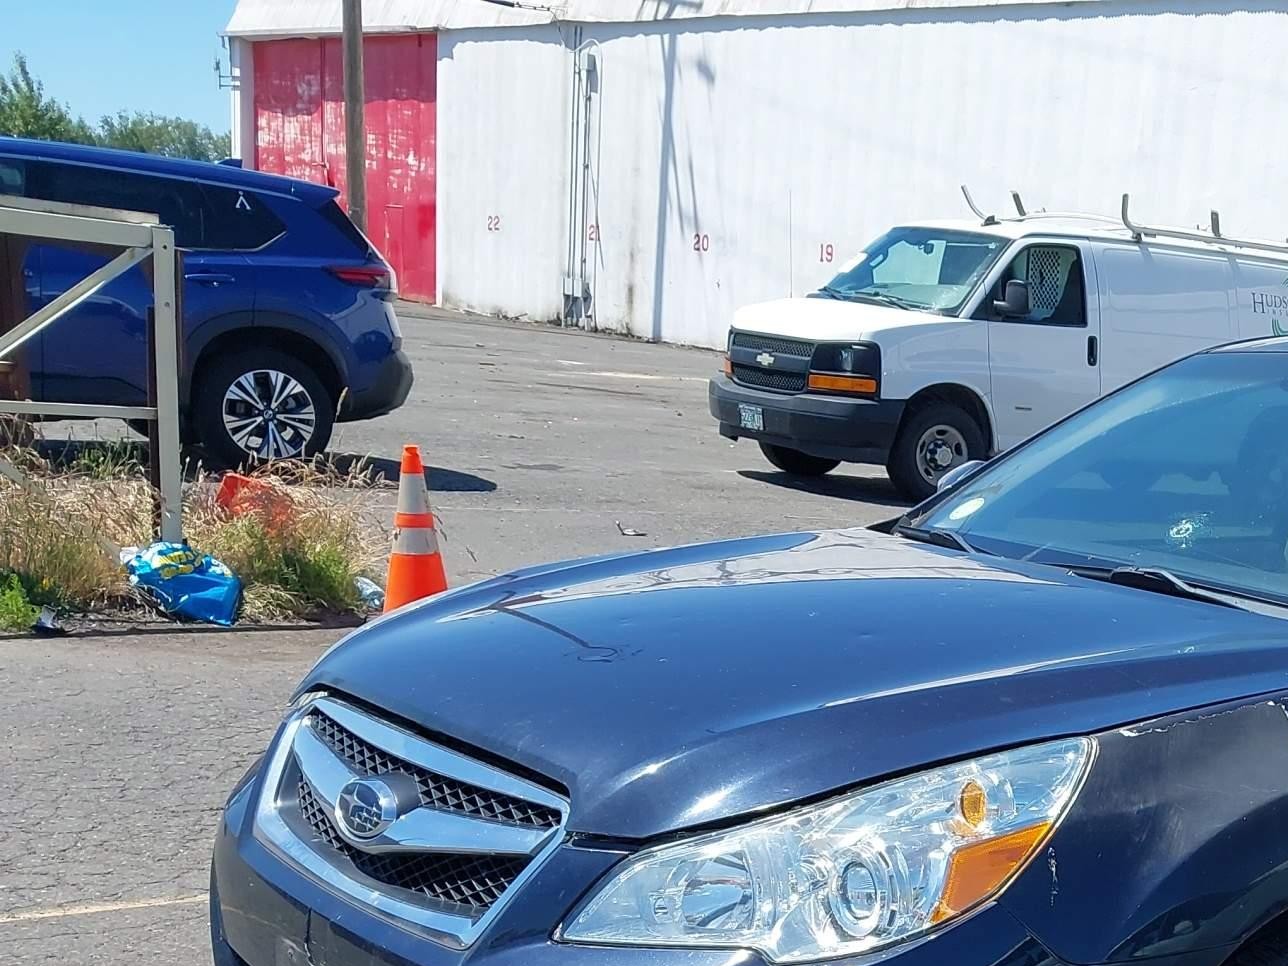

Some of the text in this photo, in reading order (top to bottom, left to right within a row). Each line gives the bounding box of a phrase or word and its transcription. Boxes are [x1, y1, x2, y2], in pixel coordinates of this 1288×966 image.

[487, 215, 501, 231] 22
[693, 233, 709, 251] 20
[819, 243, 834, 262] 19
